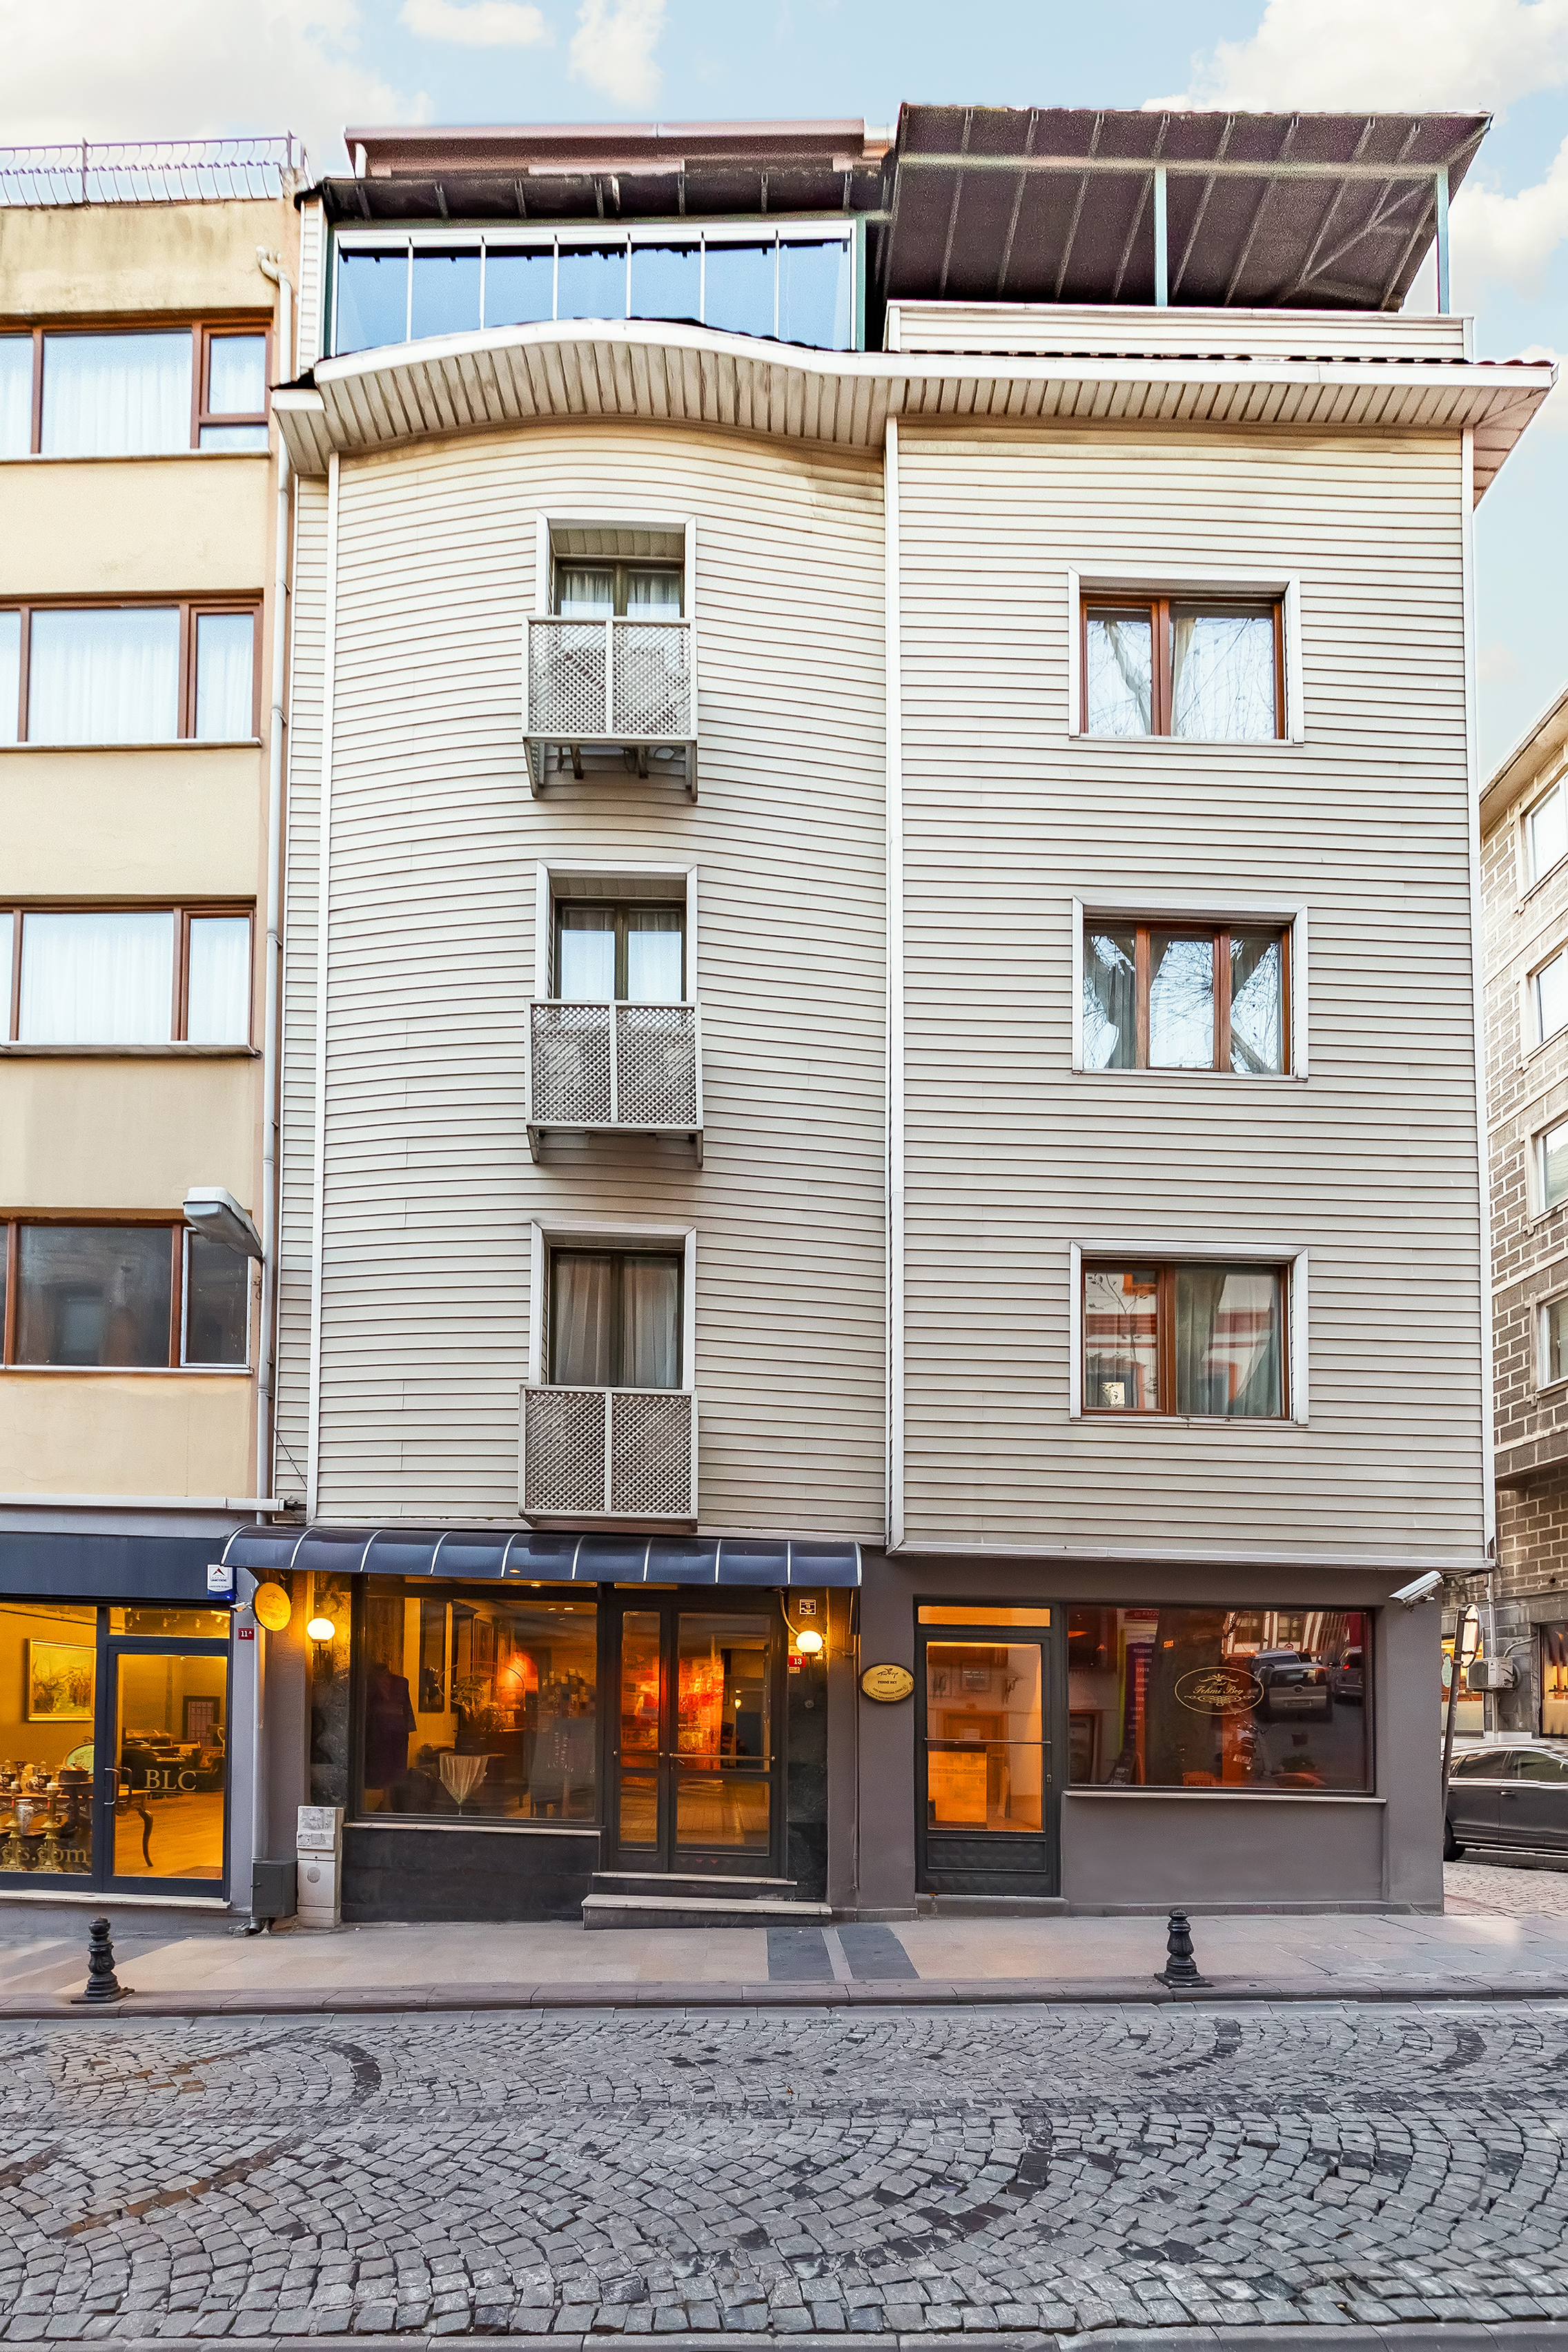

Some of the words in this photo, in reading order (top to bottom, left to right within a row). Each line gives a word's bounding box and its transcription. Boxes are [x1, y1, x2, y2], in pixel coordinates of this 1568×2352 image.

[1193, 1685, 1222, 1694] Fehmi
[1223, 1685, 1244, 1696] Bey
[144, 1769, 197, 1791] BLC
